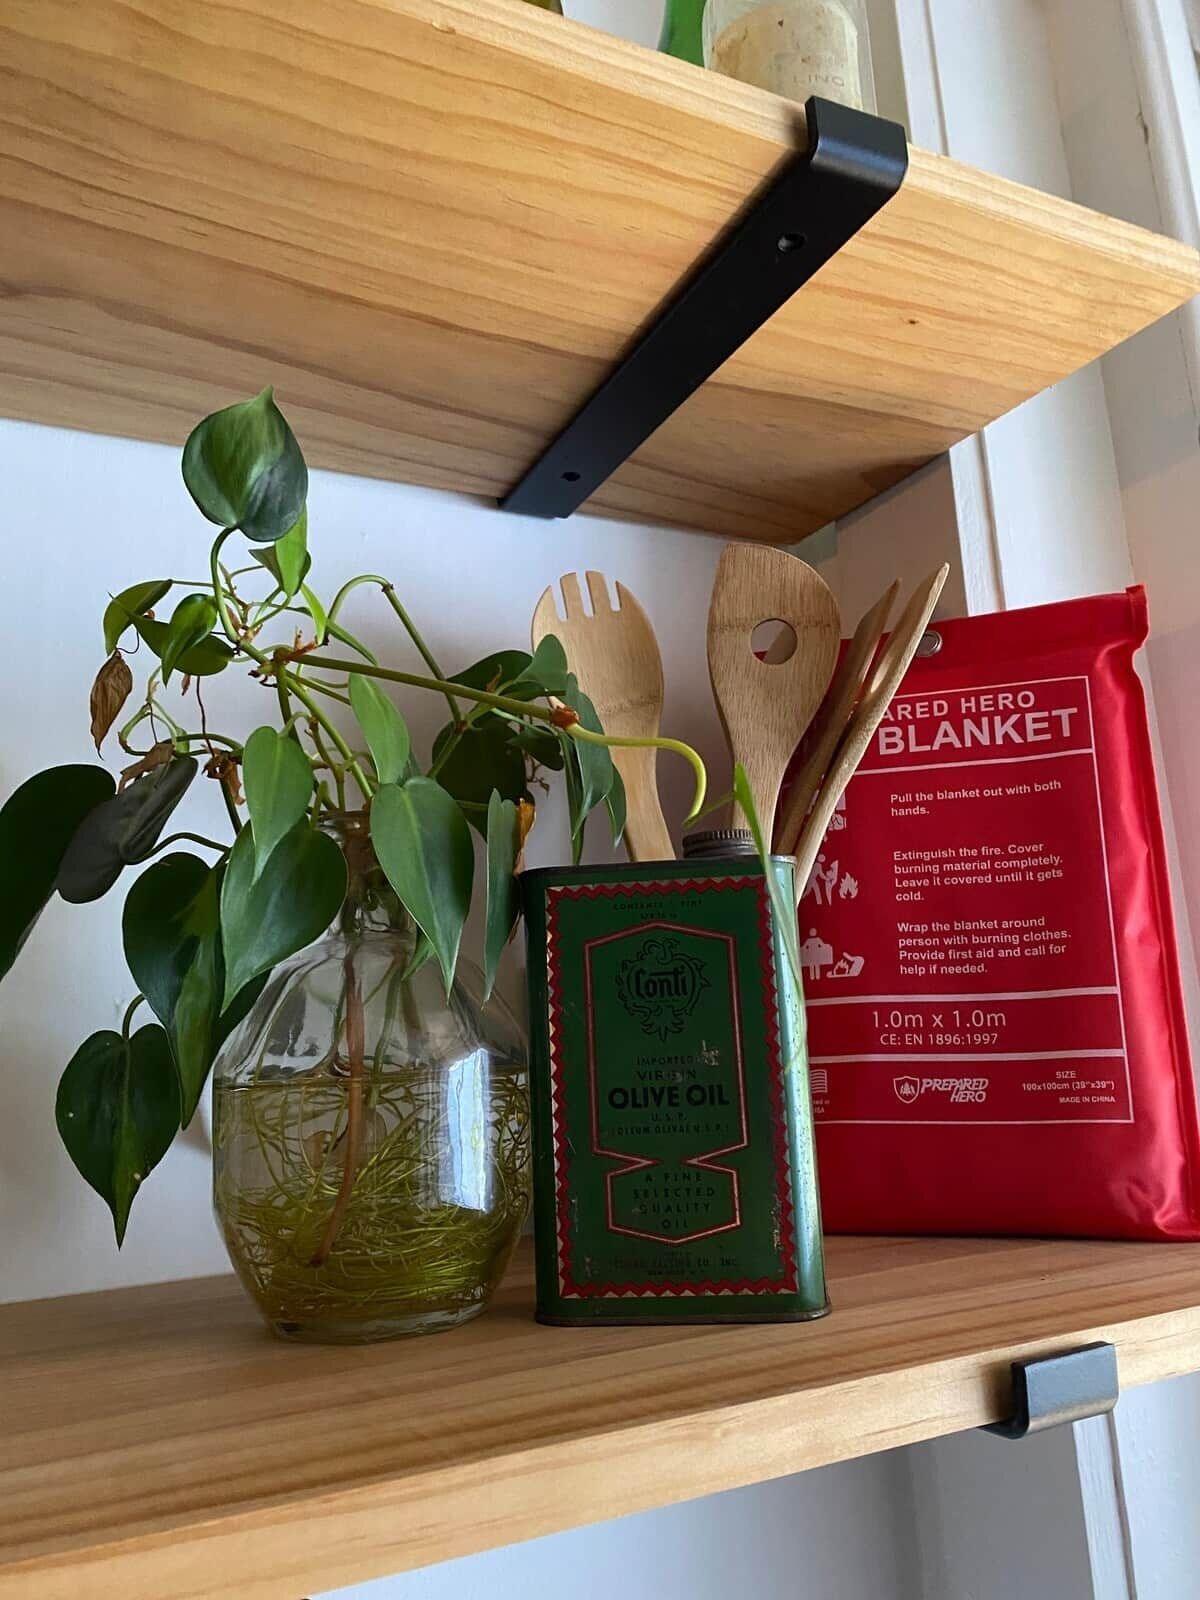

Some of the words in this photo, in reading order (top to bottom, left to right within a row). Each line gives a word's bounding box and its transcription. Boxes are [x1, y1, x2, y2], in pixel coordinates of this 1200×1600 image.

[961, 691, 1035, 713] HERO
[879, 707, 1078, 755] BLANKET
[891, 793, 912, 803] Pull
[916, 791, 934, 801] the
[937, 788, 980, 800] blanket
[983, 787, 1003, 796] out
[1006, 783, 1031, 795] with
[1034, 779, 1062, 792] both
[891, 805, 930, 816] hands.
[894, 848, 956, 861] Extinguish
[959, 847, 978, 857] the
[982, 845, 1005, 856] fire.
[1008, 843, 1044, 854] Cover
[895, 862, 939, 875] burning
[943, 859, 991, 871] material
[994, 854, 1063, 870] completely.
[895, 877, 930, 887] Leave
[933, 875, 941, 886] it
[944, 873, 992, 885] covered
[995, 871, 1022, 883] until
[1025, 869, 1034, 880] it
[1037, 867, 1063, 881] gets
[896, 891, 925, 901] cold.
[897, 922, 928, 934] Wrap
[931, 921, 950, 931] the
[953, 919, 998, 931] blanket
[1001, 916, 1046, 928] around
[898, 938, 939, 948] person
[943, 934, 968, 945] with
[971, 931, 1020, 945] burning
[1023, 928, 1072, 942] clothes.
[899, 950, 945, 960] Provide
[948, 947, 972, 959] first
[975, 948, 994, 959] aid
[997, 946, 1021, 957] and
[1024, 944, 1046, 956] call
[1049, 943, 1067, 955] for
[900, 964, 926, 976] help
[929, 964, 936, 974] if
[940, 963, 988, 975] needed.
[635, 965, 688, 998] Conti
[872, 1010, 924, 1028] 1.0m
[932, 1014, 944, 1027] x
[952, 1009, 1006, 1028] 1.0m
[880, 1033, 901, 1046] CE:
[905, 1033, 923, 1045] EN
[928, 1033, 998, 1046] 1896:1997
[1055, 1070, 1077, 1079] SIZE
[920, 1078, 989, 1094] PREPARED
[607, 1086, 681, 1109] OLIVE
[686, 1083, 730, 1106] OIL
[950, 1090, 986, 1103] HERO
[663, 1172, 703, 1183] FINE
[632, 1186, 715, 1199] SELECTED
[638, 1202, 711, 1215] QUALITY
[661, 1219, 689, 1230] OIL
